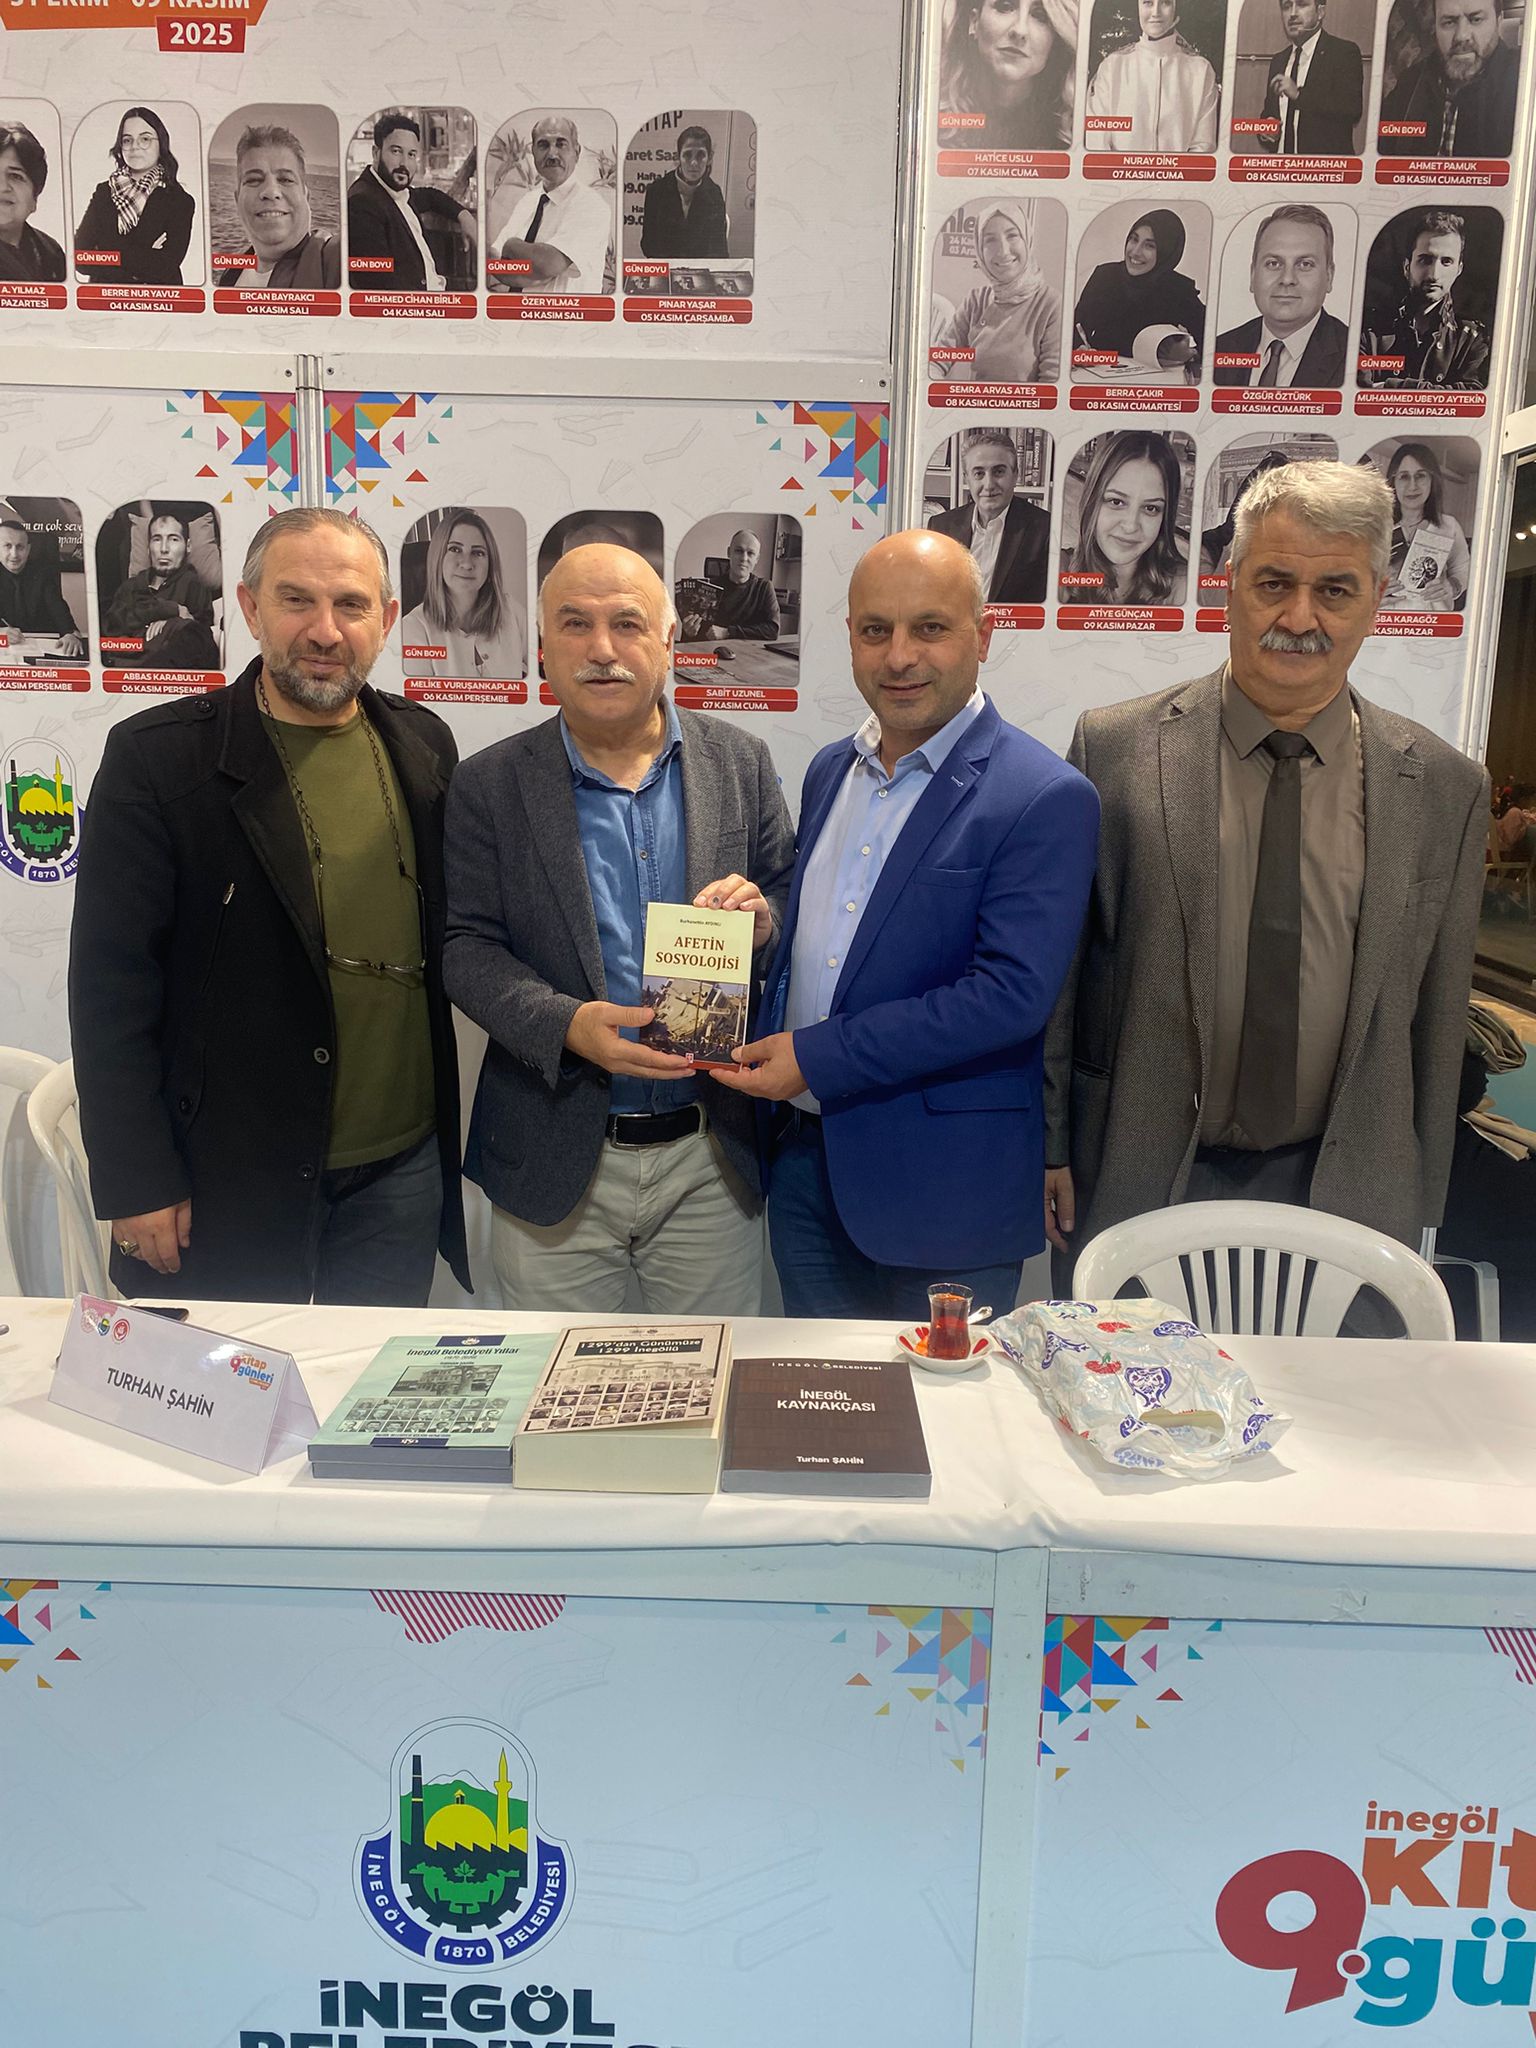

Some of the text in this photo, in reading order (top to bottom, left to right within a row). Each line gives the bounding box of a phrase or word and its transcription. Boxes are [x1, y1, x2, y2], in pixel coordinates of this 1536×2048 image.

[170, 22, 232, 44] 2025
[941, 116, 984, 126] GÜN BOYU
[1233, 121, 1277, 131] GÜN BOYU
[974, 152, 1033, 162] HATİCE USLU
[1123, 155, 1178, 167] NURAY DİNÇ
[1242, 158, 1347, 169] MEHMET ŞAH MARHAN
[1408, 161, 1476, 170] AHMET PAMUK
[966, 167, 1038, 176] 07 KASIM CUMA
[1112, 170, 1184, 179] 07 KASIM CUMA
[1245, 171, 1344, 182] 08 KASIM CUMARTESİ
[1392, 173, 1491, 185] 08 KASIM CUMARTESİ
[76, 252, 94, 261] GÜN
[350, 258, 368, 268] GÜN
[625, 263, 667, 273] GÜN BOYU
[11, 286, 46, 294] YILMAZ
[101, 288, 180, 298] BERRE NUR YAVUZ
[239, 292, 314, 301] ERCAN BAYRAKCI
[364, 293, 461, 304] MEHMED CİHAN BİRLİK
[521, 296, 579, 306] ÖZER YILMAZ
[0, 297, 49, 308] PAZARTESİ
[109, 301, 172, 311] 04 KASIM SALI
[658, 300, 716, 310] PINAR YAŞAR
[246, 305, 309, 314] 04 KASIM SALI
[382, 308, 445, 317] 04 KASIM SALI
[520, 310, 584, 319] 04 KASIM SALI
[640, 313, 735, 324] 05 KASIM ÇARŞAMBA
[1073, 352, 1116, 363] GÜN BOYU
[1360, 357, 1404, 368] GÜN BOYU
[949, 385, 1036, 396] SEMRA ARVAS ATEŞ
[1105, 388, 1163, 399] BERRA ÇAKIR
[1242, 390, 1311, 400] ÖZGÜR ÖZTÜRK
[945, 397, 1040, 408] 08 KASIM CUMARTESİ
[1356, 393, 1485, 403] MUHAMMED UBEYD AYTEKİN
[1086, 400, 1181, 410] 08 KASIM CUMARTESİ
[1228, 402, 1324, 413] 08 KASIM CUMARTESİ
[1381, 406, 1456, 416] 09 KASIM PAZAR
[1201, 578, 1220, 586] GÜN
[1088, 607, 1153, 620] ATİYE GÜNÇAN
[1393, 613, 1438, 624] KARAGÖZ
[994, 620, 1016, 629] AZAR
[1083, 621, 1155, 630] 09 KASIM PAZAR
[1403, 627, 1433, 635] PAZAR
[101, 640, 119, 649] GÜN
[676, 655, 718, 665] GÜN BOYU
[31, 668, 58, 678] DEMİR
[122, 672, 205, 681] ABBAS KARABULUT
[27, 682, 72, 692] PERŞEMBE
[133, 684, 162, 693] KASIM
[162, 685, 207, 695] PERŞEMBE
[410, 678, 520, 692] MELİKE VURUŞANKAPLAN
[706, 687, 766, 697] SABİT UZUNEL
[422, 692, 509, 704] 06 KASIM PERŞEMBE
[702, 700, 768, 710] 07 KASIM CUMA
[32, 870, 56, 878] 1870
[674, 936, 725, 951] AFETİN
[656, 952, 740, 971] SOSYOLOJİSİ
[238, 1366, 274, 1384] günleri
[107, 1367, 214, 1418] TURHAN ŞAHİN
[800, 1389, 852, 1400] İNEGÖL
[777, 1400, 876, 1412] KAYNAKÇASI
[832, 1456, 864, 1465] ŞAHİN
[1366, 1800, 1498, 1840] inegöl
[368, 1854, 407, 1934] İNEGÖL
[503, 1860, 560, 1949] BELEDİYESİ
[441, 1944, 487, 1958] 1870
[320, 1979, 615, 2038] İNEGÖL
